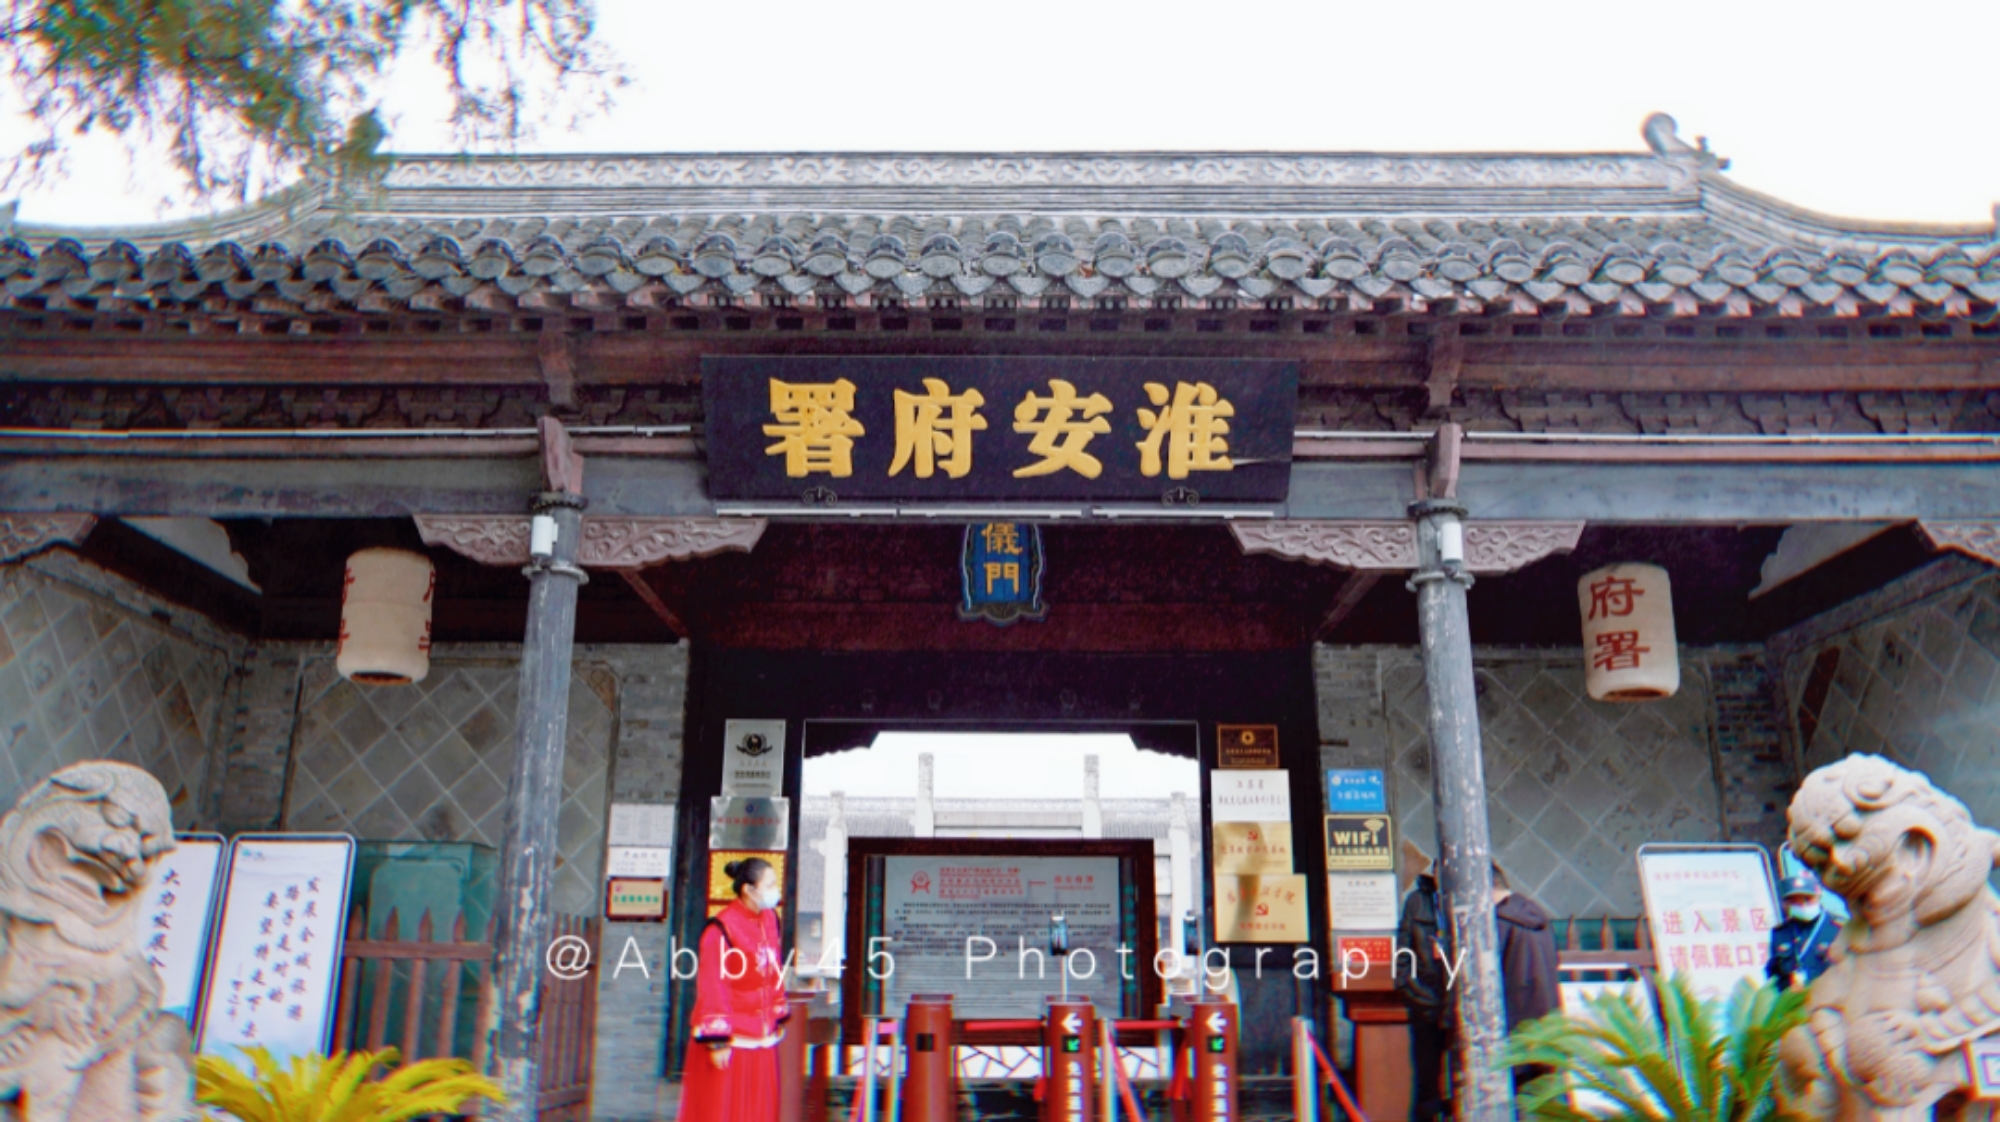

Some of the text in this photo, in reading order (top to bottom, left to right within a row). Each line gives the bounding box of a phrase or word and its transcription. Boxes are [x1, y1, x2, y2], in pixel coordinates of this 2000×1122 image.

[763, 377, 1235, 479] 淮安府署
[981, 522, 1023, 595] 儀門
[1588, 575, 1651, 671] 府署
[1662, 907, 1769, 935] 进入景区
